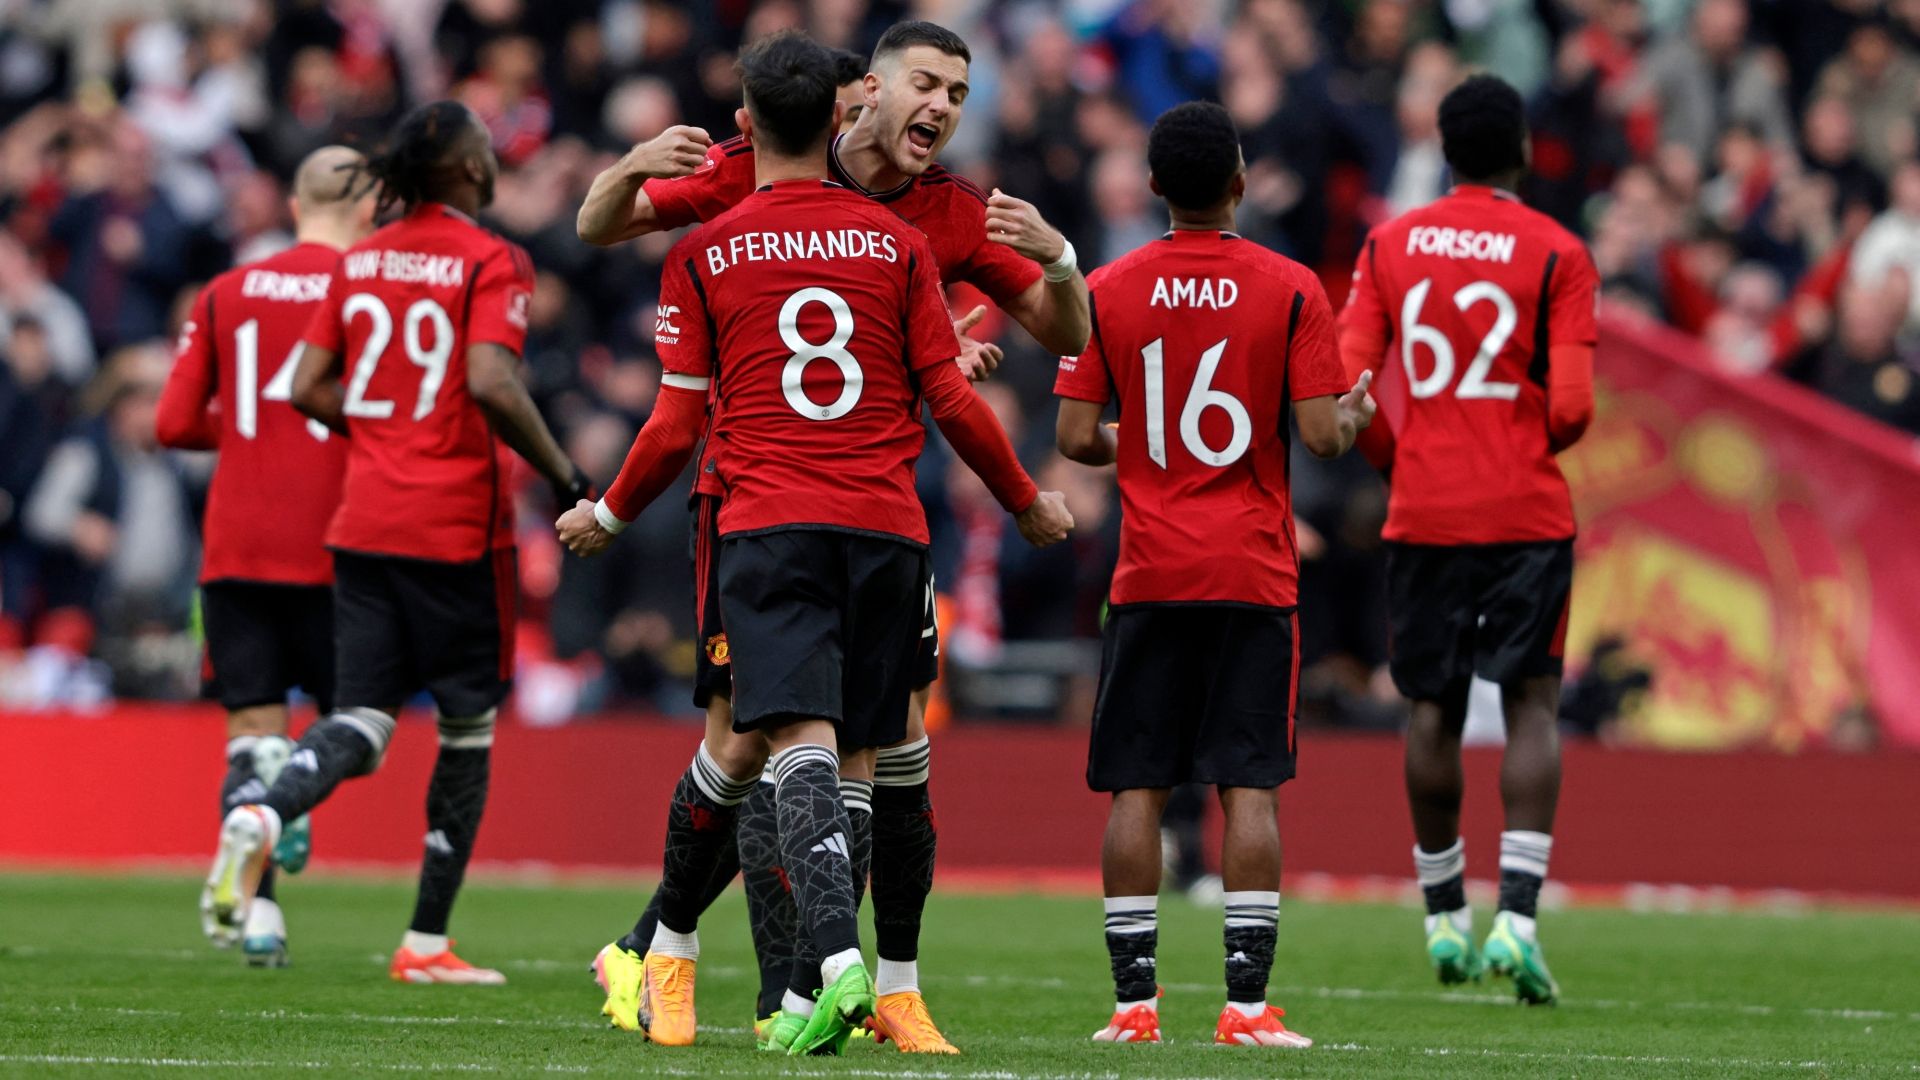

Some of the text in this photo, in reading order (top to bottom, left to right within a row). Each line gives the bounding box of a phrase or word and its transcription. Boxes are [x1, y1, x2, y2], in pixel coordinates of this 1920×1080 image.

[706, 229, 898, 276] B.FERNANDES
[1150, 277, 1238, 311] AMAD
[1406, 226, 1516, 263] FORSON
[342, 292, 455, 422] 29
[777, 286, 864, 421] 8
[1401, 278, 1520, 400] 62
[1140, 336, 1252, 471] 16
